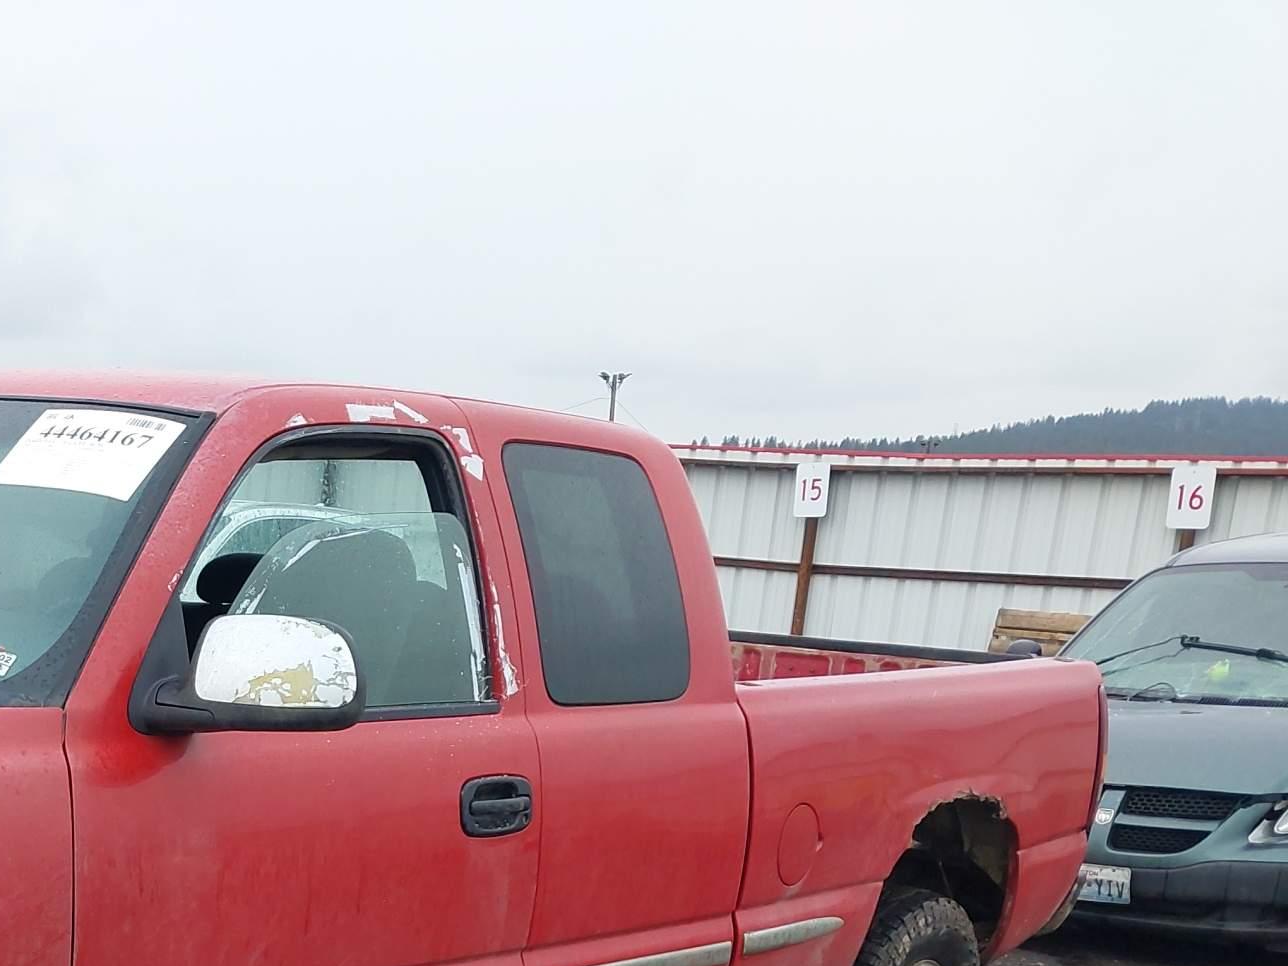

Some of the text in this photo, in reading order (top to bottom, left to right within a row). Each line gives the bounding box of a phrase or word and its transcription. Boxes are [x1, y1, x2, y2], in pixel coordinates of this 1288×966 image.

[40, 425, 155, 449] 44464167
[801, 478, 822, 501] 15
[1178, 484, 1204, 510] 16
